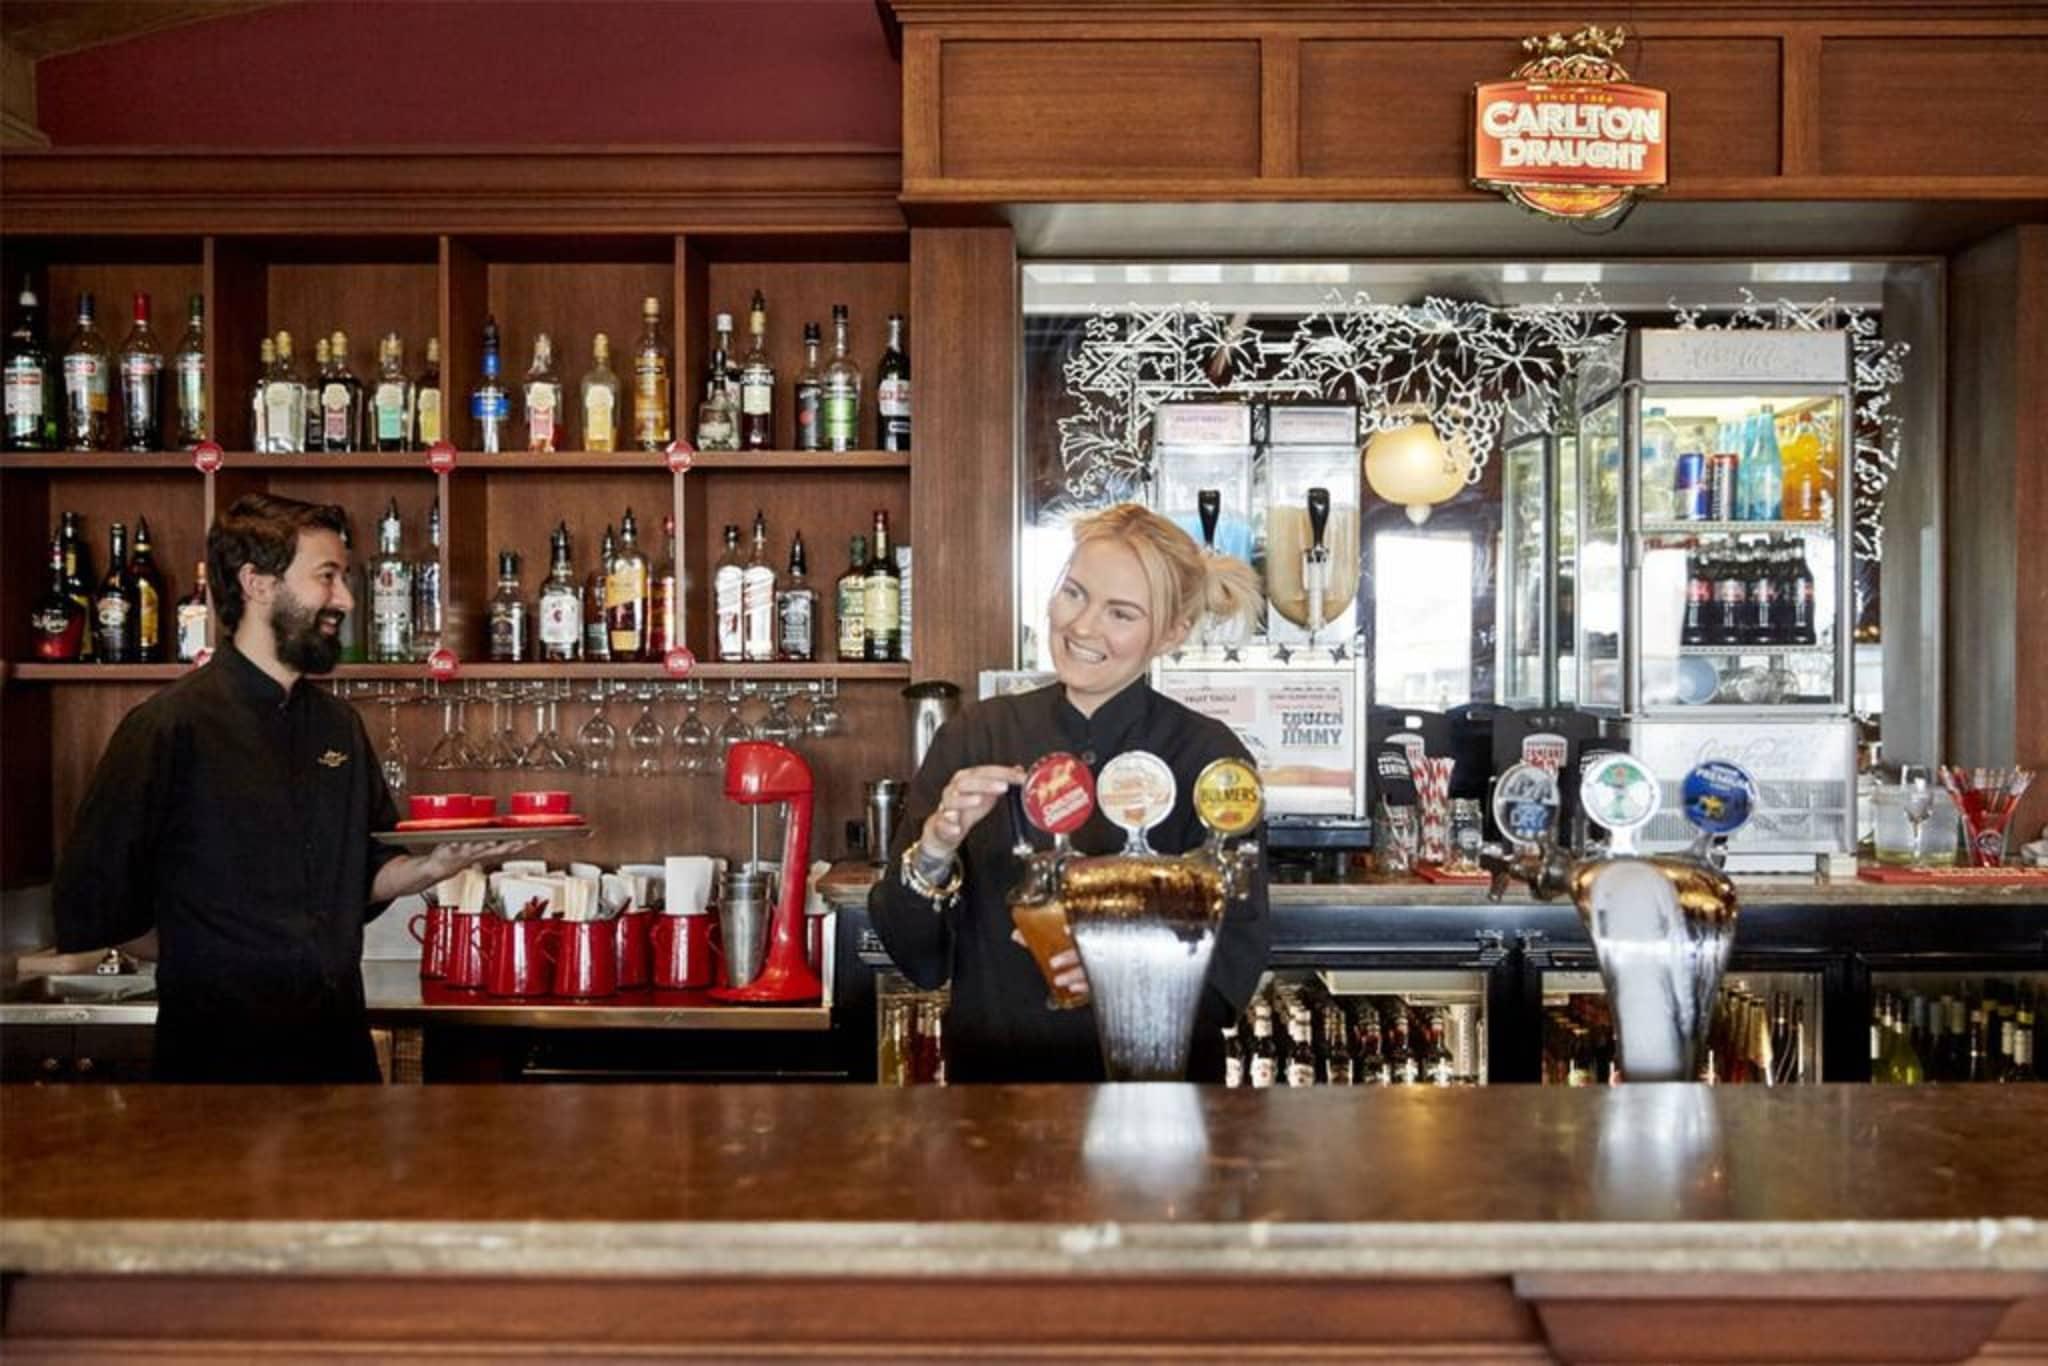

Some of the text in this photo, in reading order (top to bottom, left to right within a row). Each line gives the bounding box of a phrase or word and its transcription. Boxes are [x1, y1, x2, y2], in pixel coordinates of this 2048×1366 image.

[1482, 100, 1662, 144] CARLTON
[1500, 138, 1648, 171] DRAUGHT
[1281, 728, 1342, 745] JIMMY
